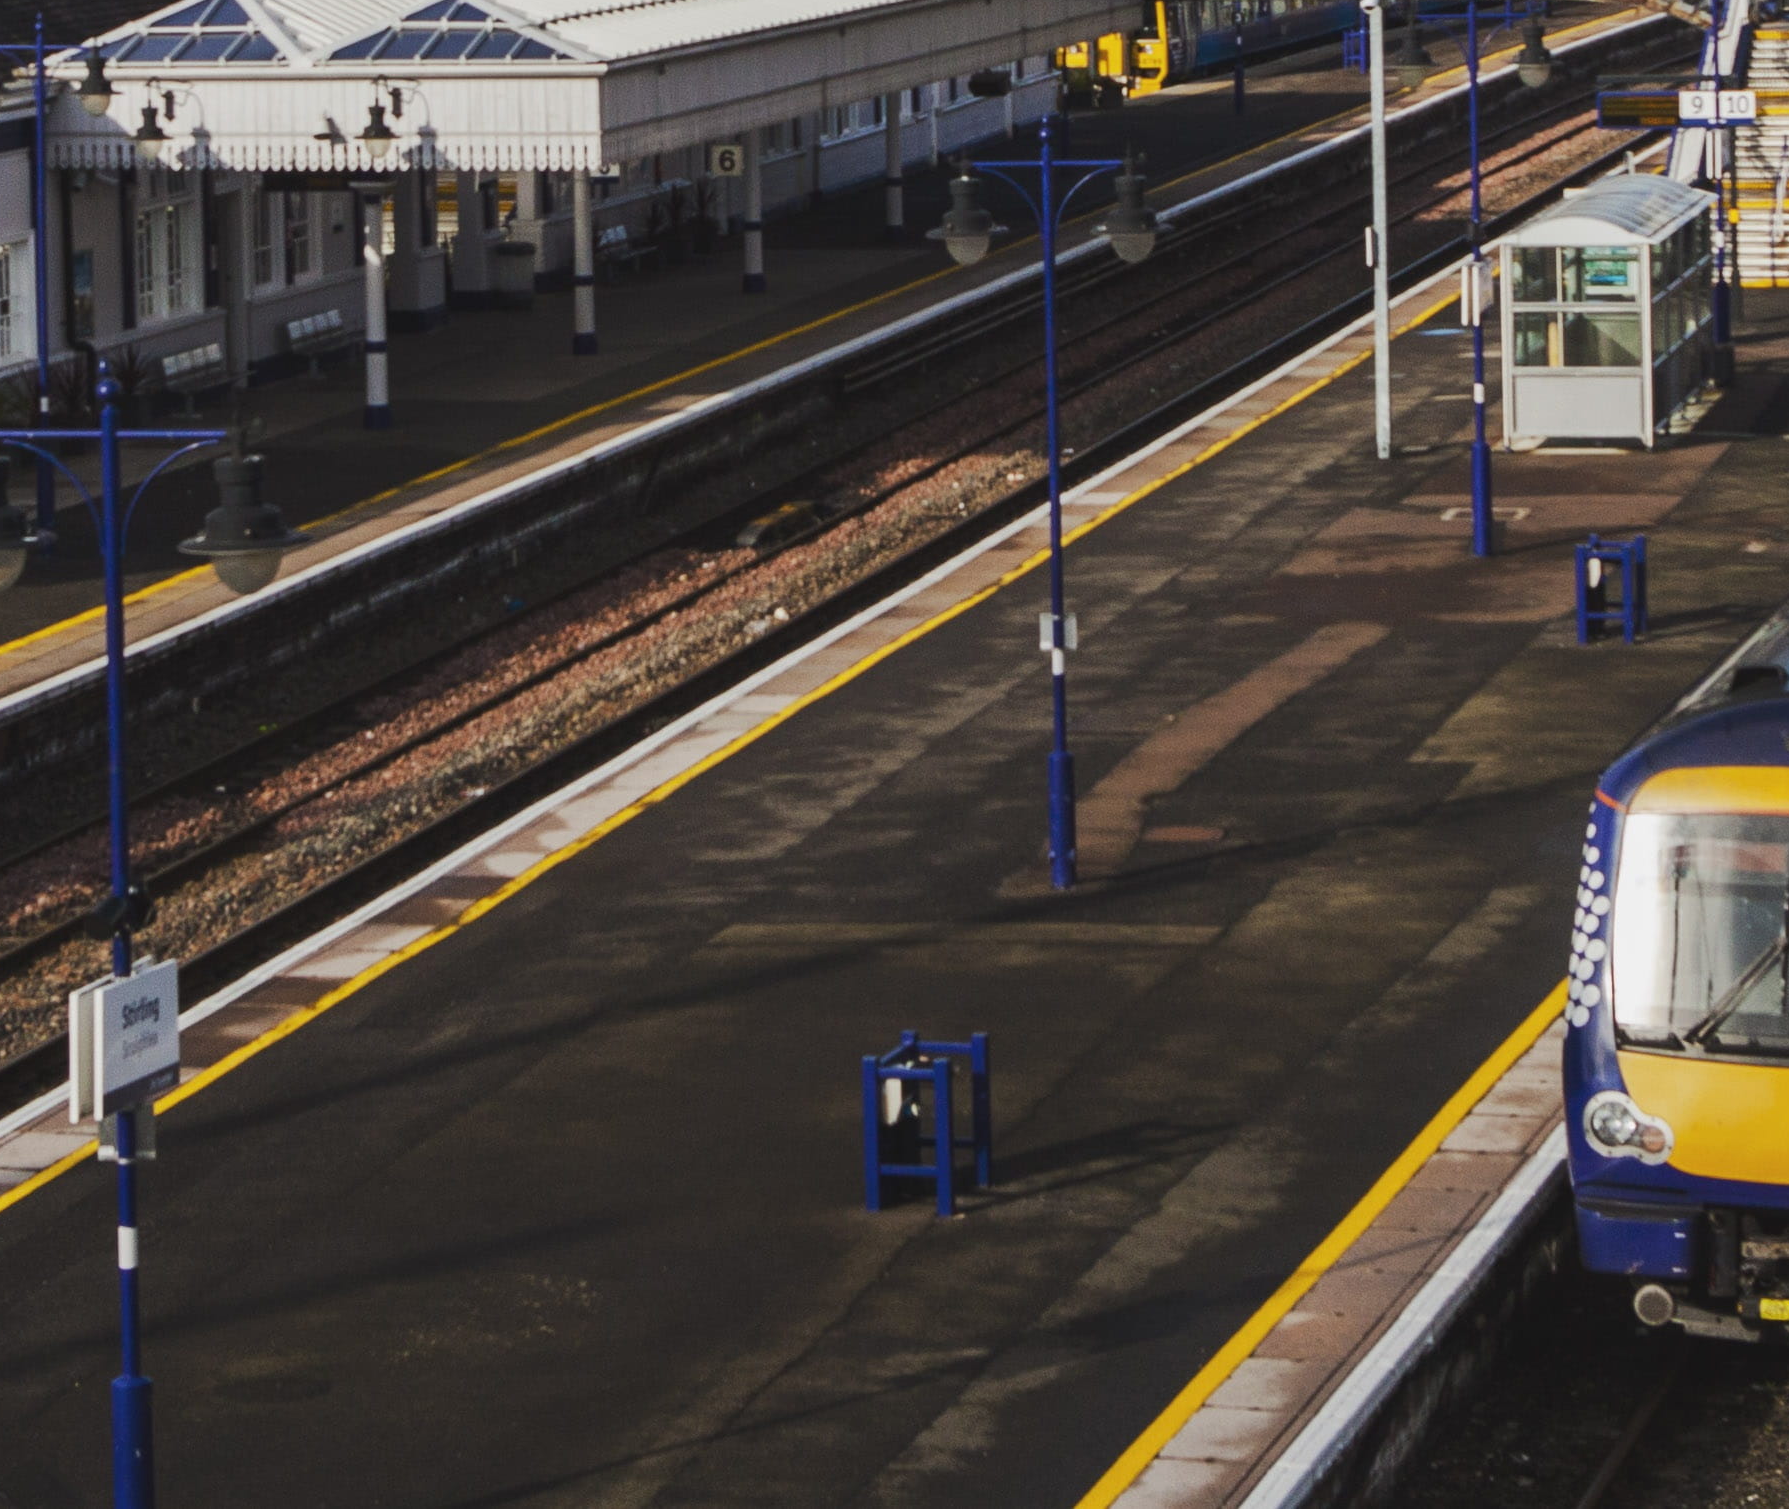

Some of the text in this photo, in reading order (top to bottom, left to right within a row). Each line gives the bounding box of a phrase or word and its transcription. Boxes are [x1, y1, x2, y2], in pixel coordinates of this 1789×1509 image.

[1692, 95, 1704, 114] 9
[1727, 95, 1750, 114] 10
[718, 149, 736, 172] 6
[122, 996, 160, 1029] Stirling
